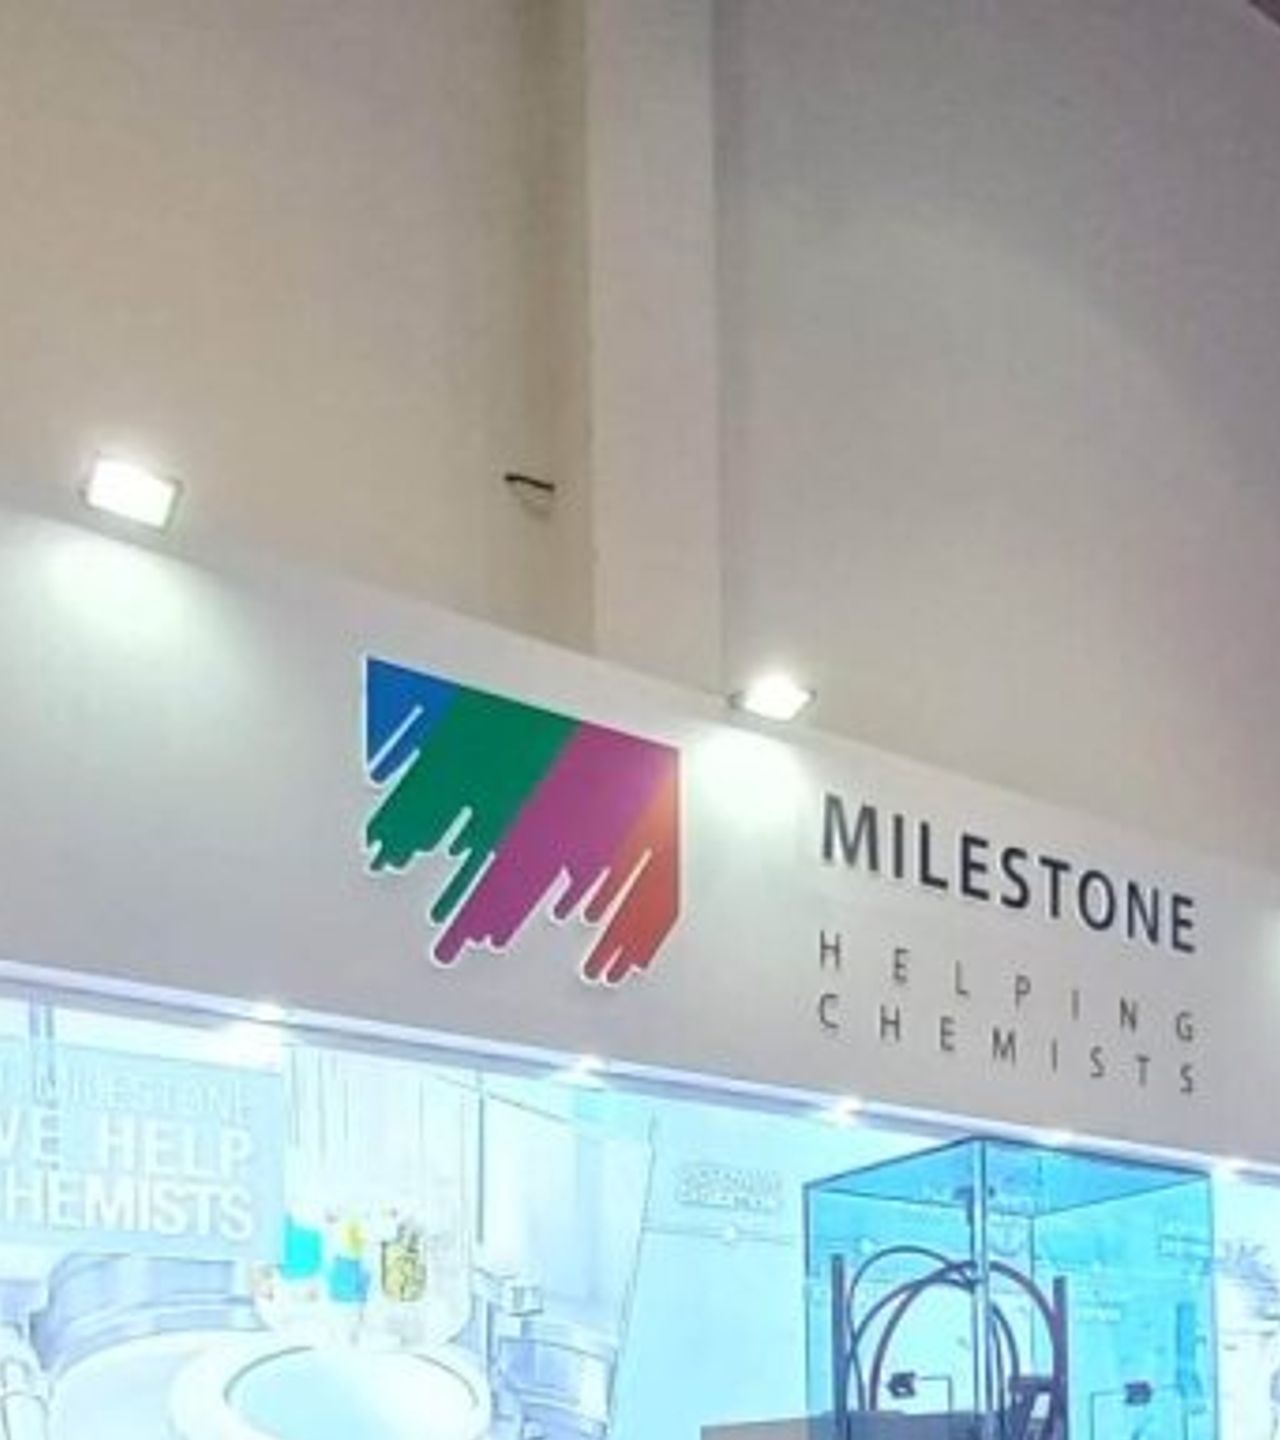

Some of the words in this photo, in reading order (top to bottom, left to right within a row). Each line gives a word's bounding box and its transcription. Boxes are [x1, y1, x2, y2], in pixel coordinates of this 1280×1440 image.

[823, 793, 1197, 955] MILESTONE
[819, 929, 1195, 1044] HELPING
[818, 993, 1196, 1095] CHEMISTS
[96, 1111, 254, 1181] HELP
